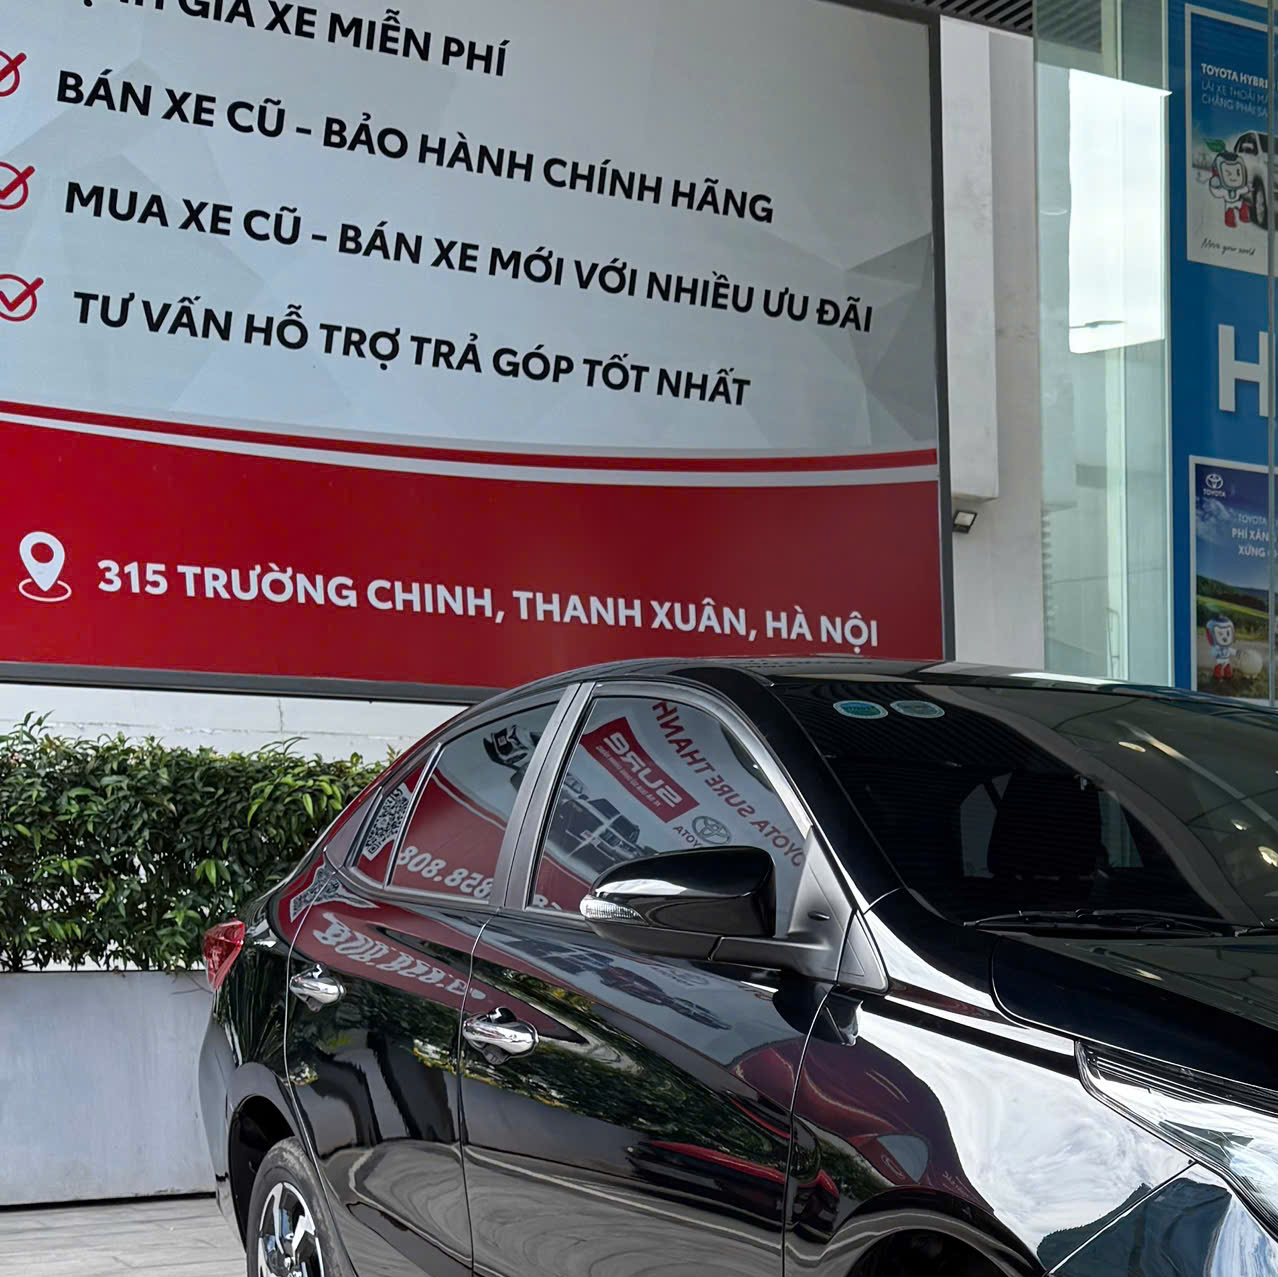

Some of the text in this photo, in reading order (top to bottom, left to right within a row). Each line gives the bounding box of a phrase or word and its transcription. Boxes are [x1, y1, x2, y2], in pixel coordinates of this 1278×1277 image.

[264, 0, 317, 39] XE
[327, 9, 431, 61] MIỄN
[442, 36, 511, 77] PHÍ
[1201, 63, 1238, 82] TOYOTA
[1240, 72, 1276, 89] HYBRI
[57, 69, 152, 117] BÁN
[161, 88, 216, 128] XE
[226, 97, 286, 139] CŨ
[323, 112, 408, 160] BẢO
[418, 132, 534, 182] HÀNH
[542, 157, 663, 205] CHÍNH
[671, 178, 775, 224] HÃNG
[64, 181, 169, 228] MUA
[178, 198, 233, 236] XE
[242, 206, 302, 246] CŨ
[338, 221, 423, 265] BÁN
[430, 238, 480, 274] XE
[488, 245, 565, 287] MỚI
[573, 257, 636, 297] VỚI
[646, 270, 755, 313] NHIỀU
[762, 287, 809, 322] ƯU
[815, 296, 873, 333] ĐÃI
[73, 291, 751, 407] TƯ VẤN HỖ TRỢ TRẢ GÓP TỐT NHẤT
[1203, 488, 1226, 498] TOYOTA
[98, 558, 880, 651] 315 TRƯỜNG CHINH, THANH XUÂN, HÀ NỘI
